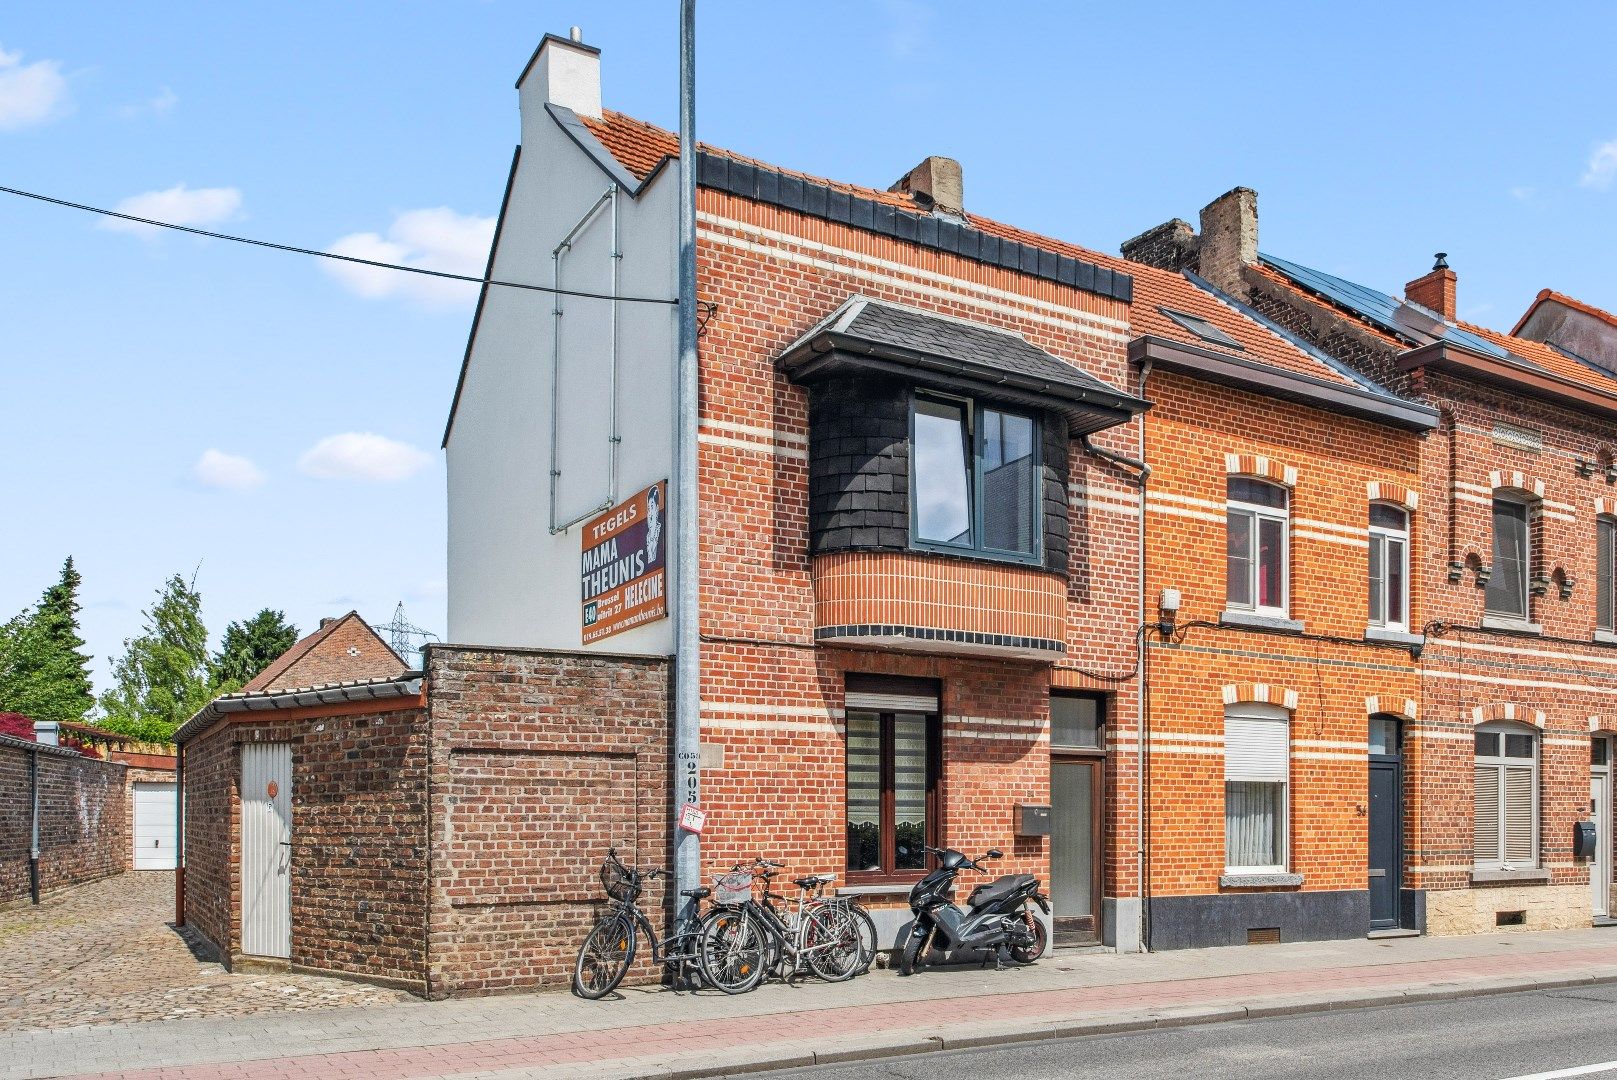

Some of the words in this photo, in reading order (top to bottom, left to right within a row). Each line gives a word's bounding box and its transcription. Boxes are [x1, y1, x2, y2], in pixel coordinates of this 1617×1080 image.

[593, 504, 636, 539] TEGELS
[582, 537, 618, 575] MAMA
[582, 549, 645, 600] THEUNIS
[585, 605, 596, 624] E40
[597, 591, 619, 608] Brussel
[614, 602, 622, 615] 27
[687, 761, 697, 804] 205
